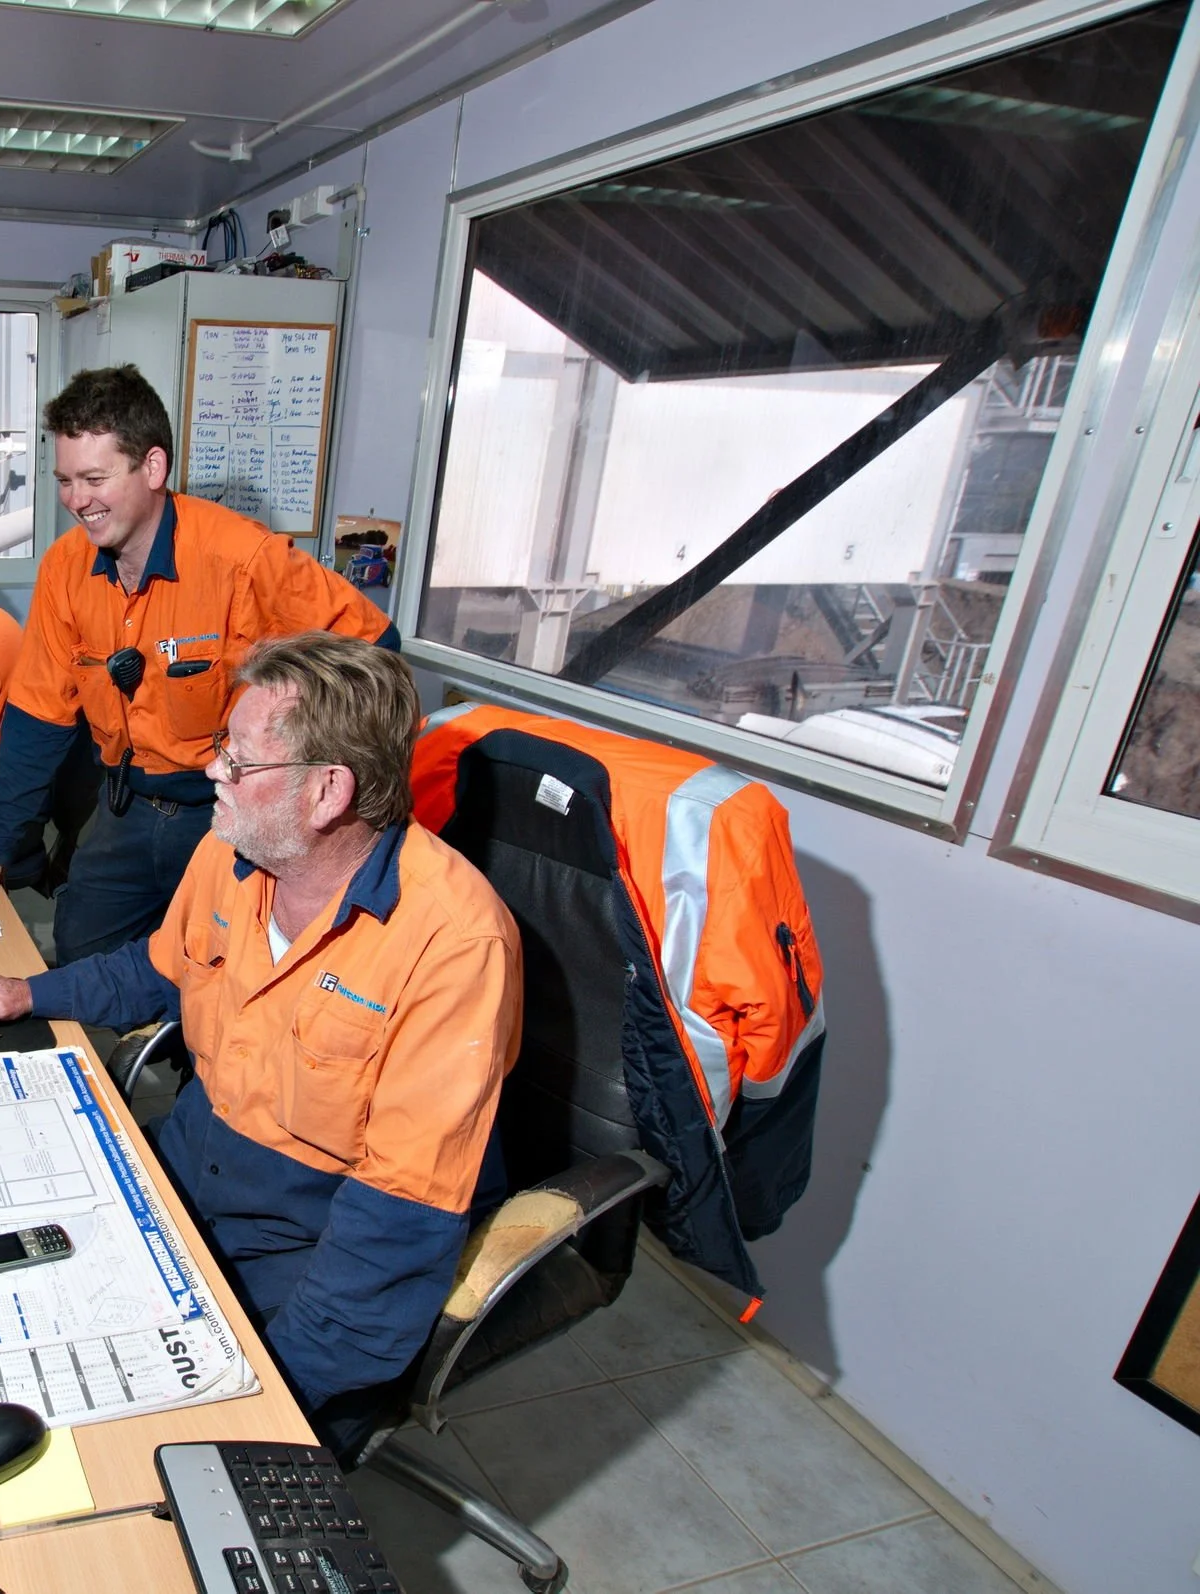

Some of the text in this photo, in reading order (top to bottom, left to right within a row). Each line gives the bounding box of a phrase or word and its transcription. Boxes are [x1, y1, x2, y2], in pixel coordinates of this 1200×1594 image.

[191, 254, 205, 265] 24
[145, 1230, 187, 1292] MEASUREMENT
[195, 1294, 237, 1362] tom.com.au
